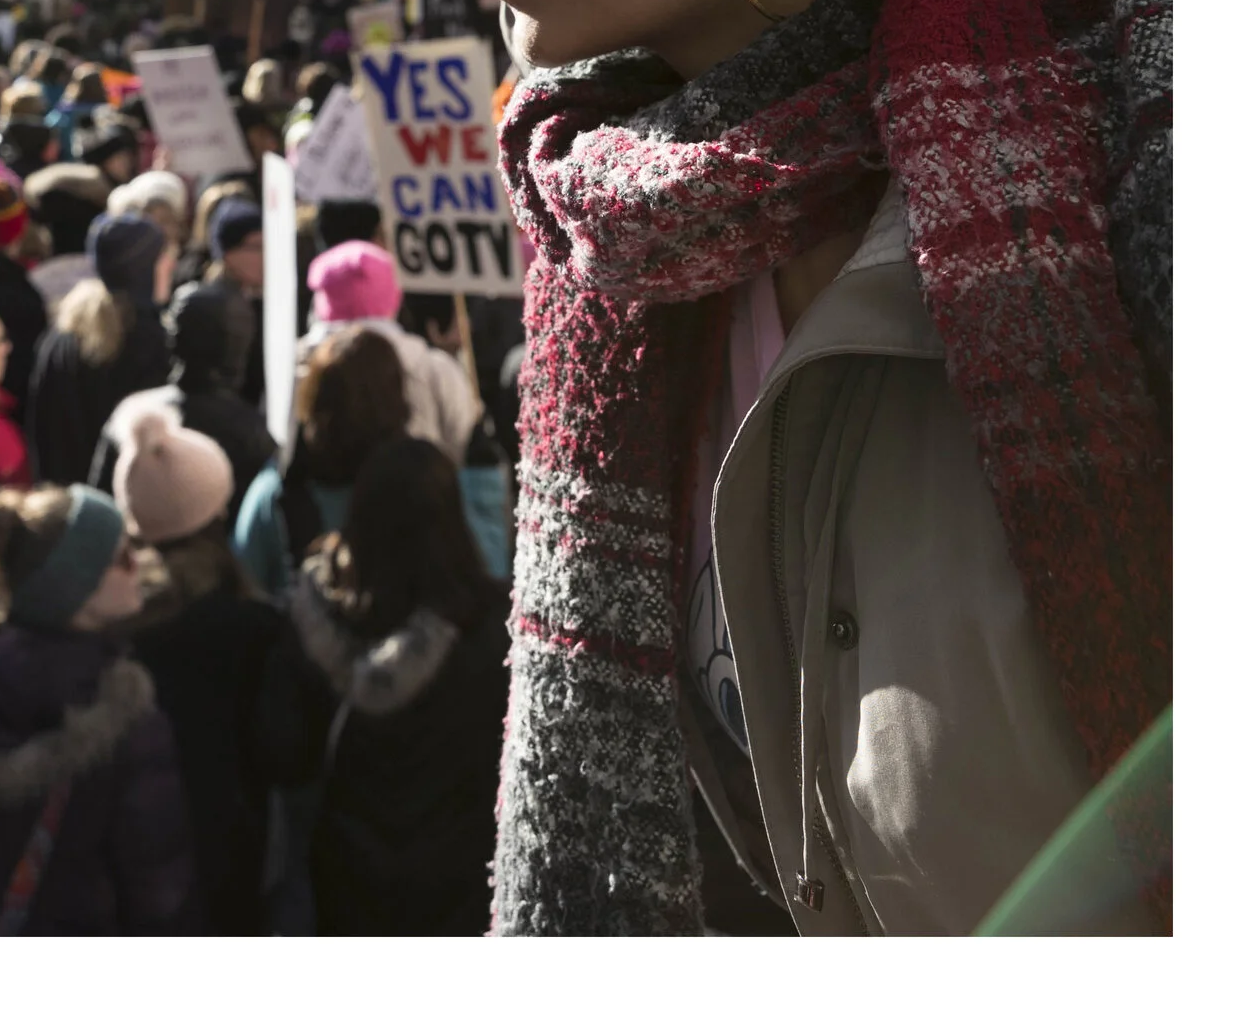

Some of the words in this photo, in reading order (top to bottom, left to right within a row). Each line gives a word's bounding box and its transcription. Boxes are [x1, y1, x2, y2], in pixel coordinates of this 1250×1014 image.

[361, 51, 472, 121] YES
[399, 124, 488, 167] WE
[393, 171, 498, 217] CAN
[395, 221, 511, 278] GOTV
